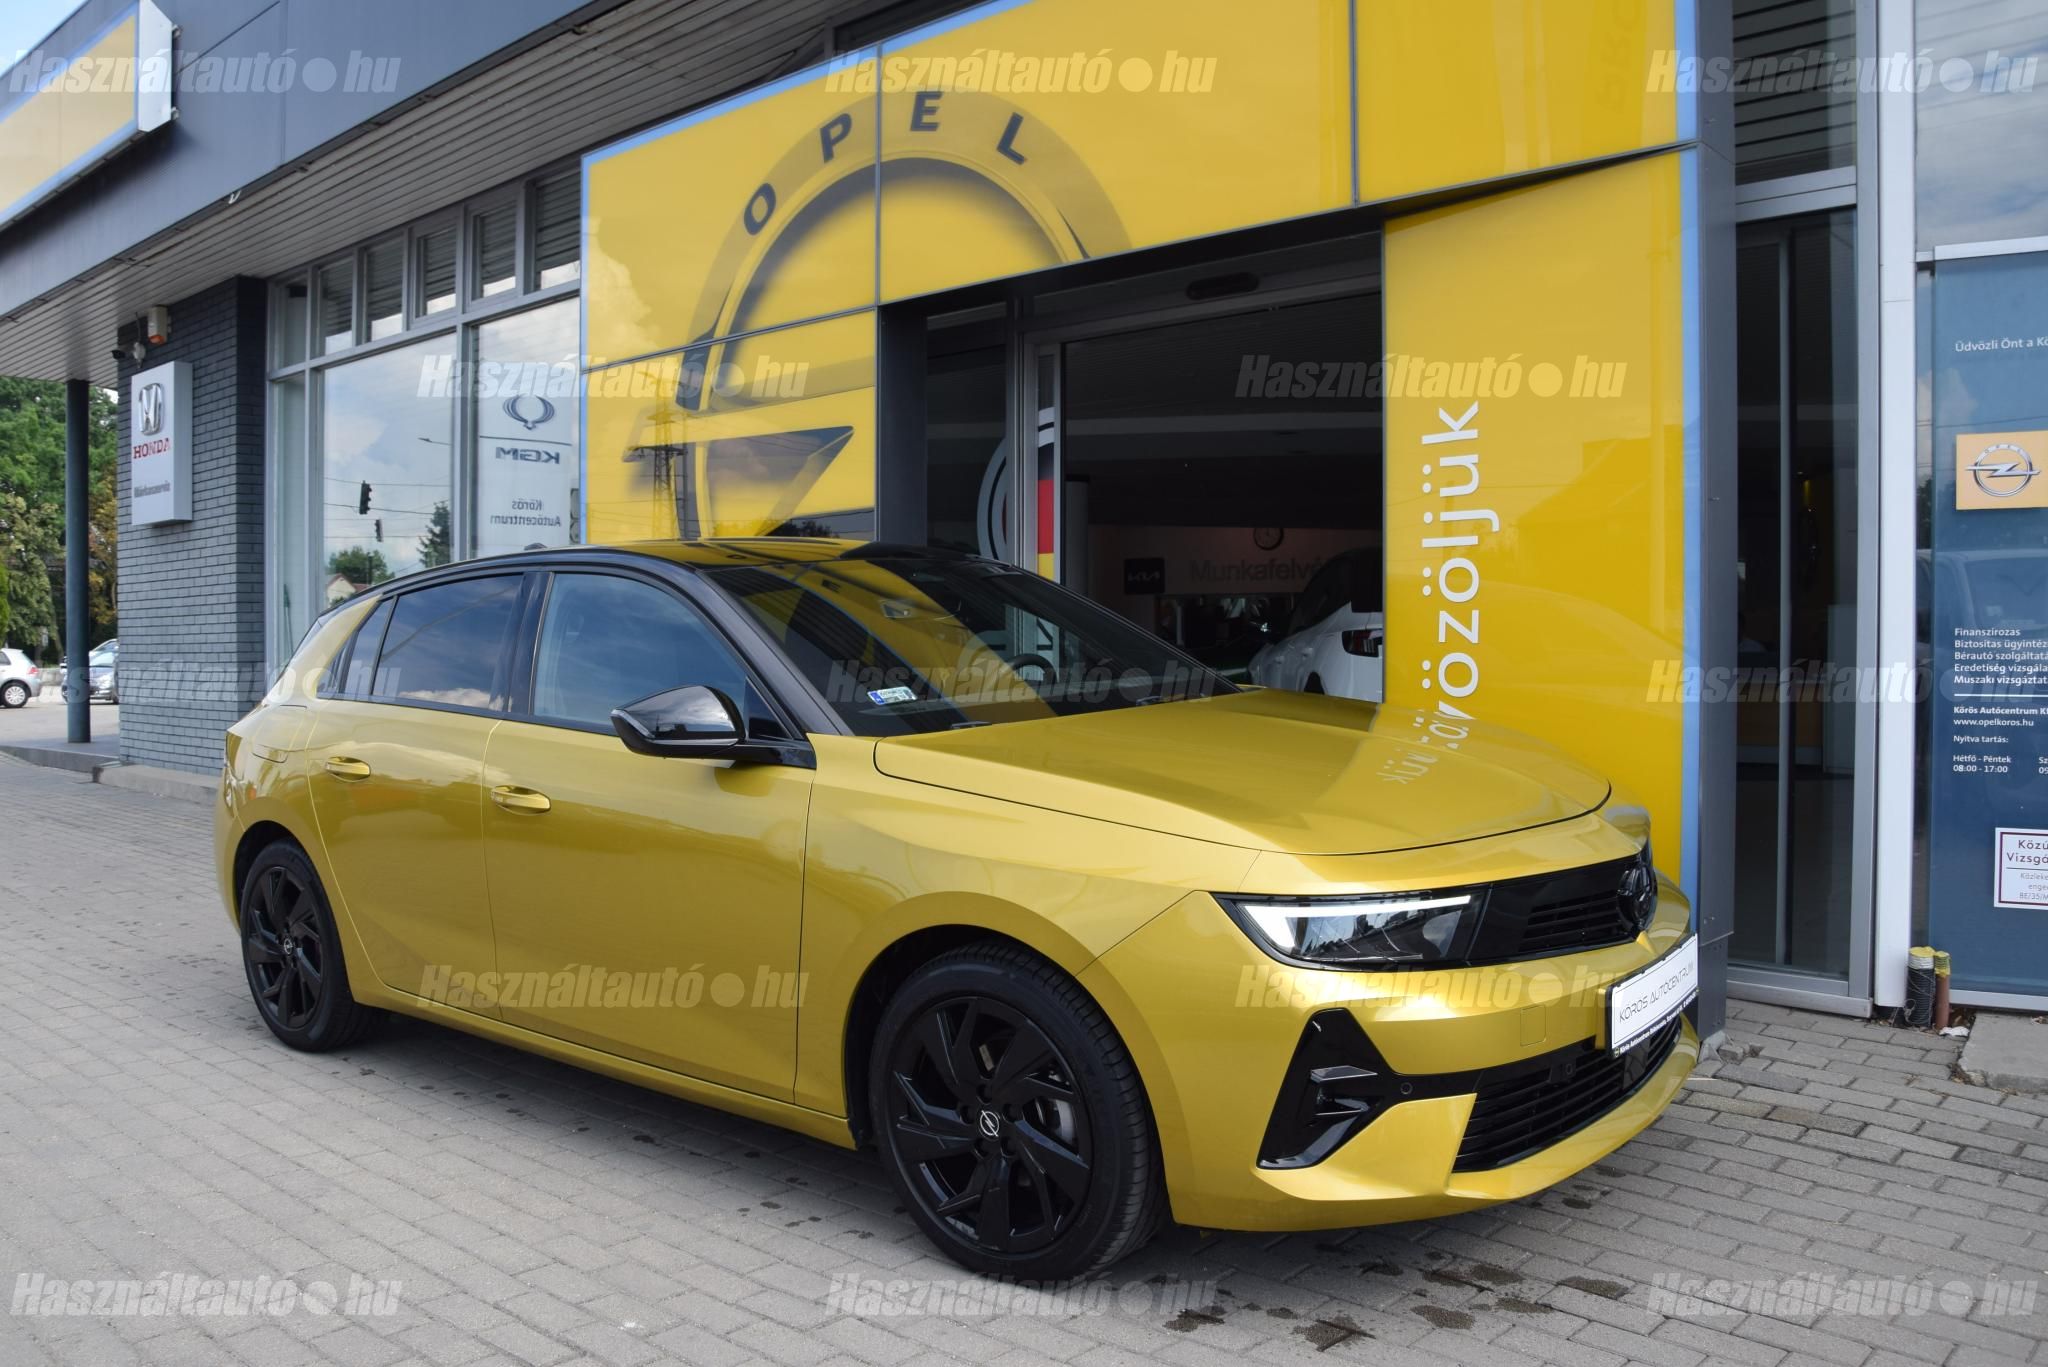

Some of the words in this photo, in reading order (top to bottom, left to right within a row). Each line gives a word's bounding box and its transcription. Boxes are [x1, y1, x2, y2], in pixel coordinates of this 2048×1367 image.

[743, 90, 1028, 236] OPEL
[2026, 339, 2034, 348] a
[133, 437, 171, 459] HONDA
[1954, 663, 2006, 675] Eredetiség
[1953, 718, 2034, 728] www.opelkoros.hu
[1953, 735, 1980, 744] Nyitva
[1983, 755, 2012, 763] Péntek
[1984, 765, 2008, 773] 17:00
